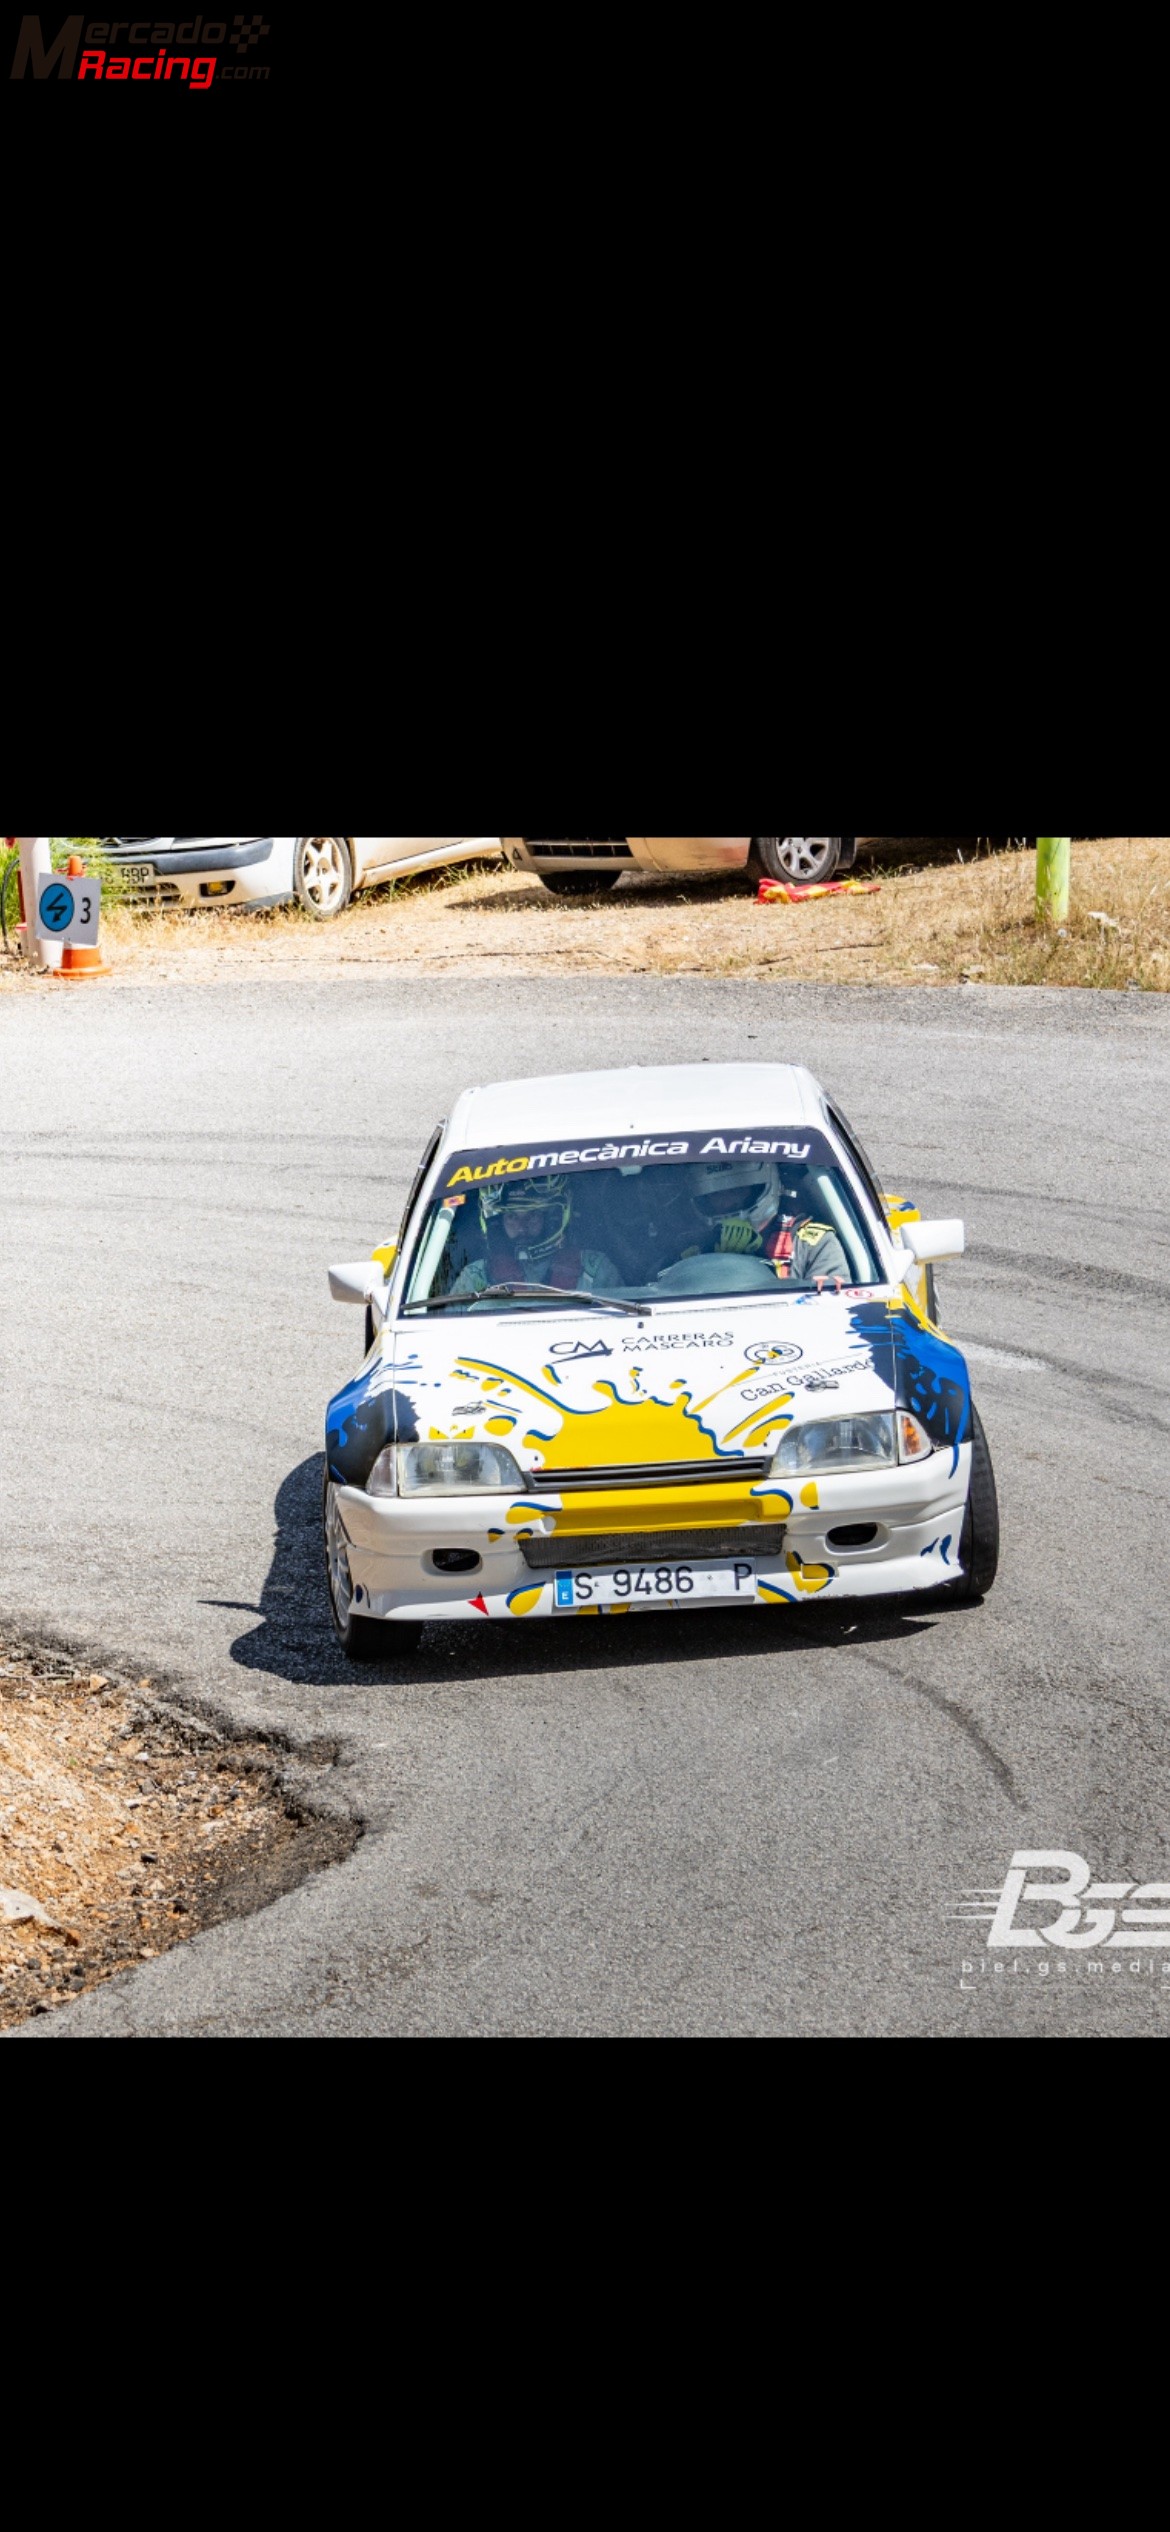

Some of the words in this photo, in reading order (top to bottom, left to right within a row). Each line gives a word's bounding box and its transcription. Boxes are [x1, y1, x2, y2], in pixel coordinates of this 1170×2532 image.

[80, 897, 91, 924] 3
[447, 1140, 689, 1187] Automecànica
[700, 1137, 811, 1158] Ariany
[621, 1331, 734, 1344] CARRERAS
[740, 1382, 786, 1401] Can
[575, 1572, 593, 1600] S
[613, 1565, 694, 1597] 9486
[734, 1562, 752, 1591] P
